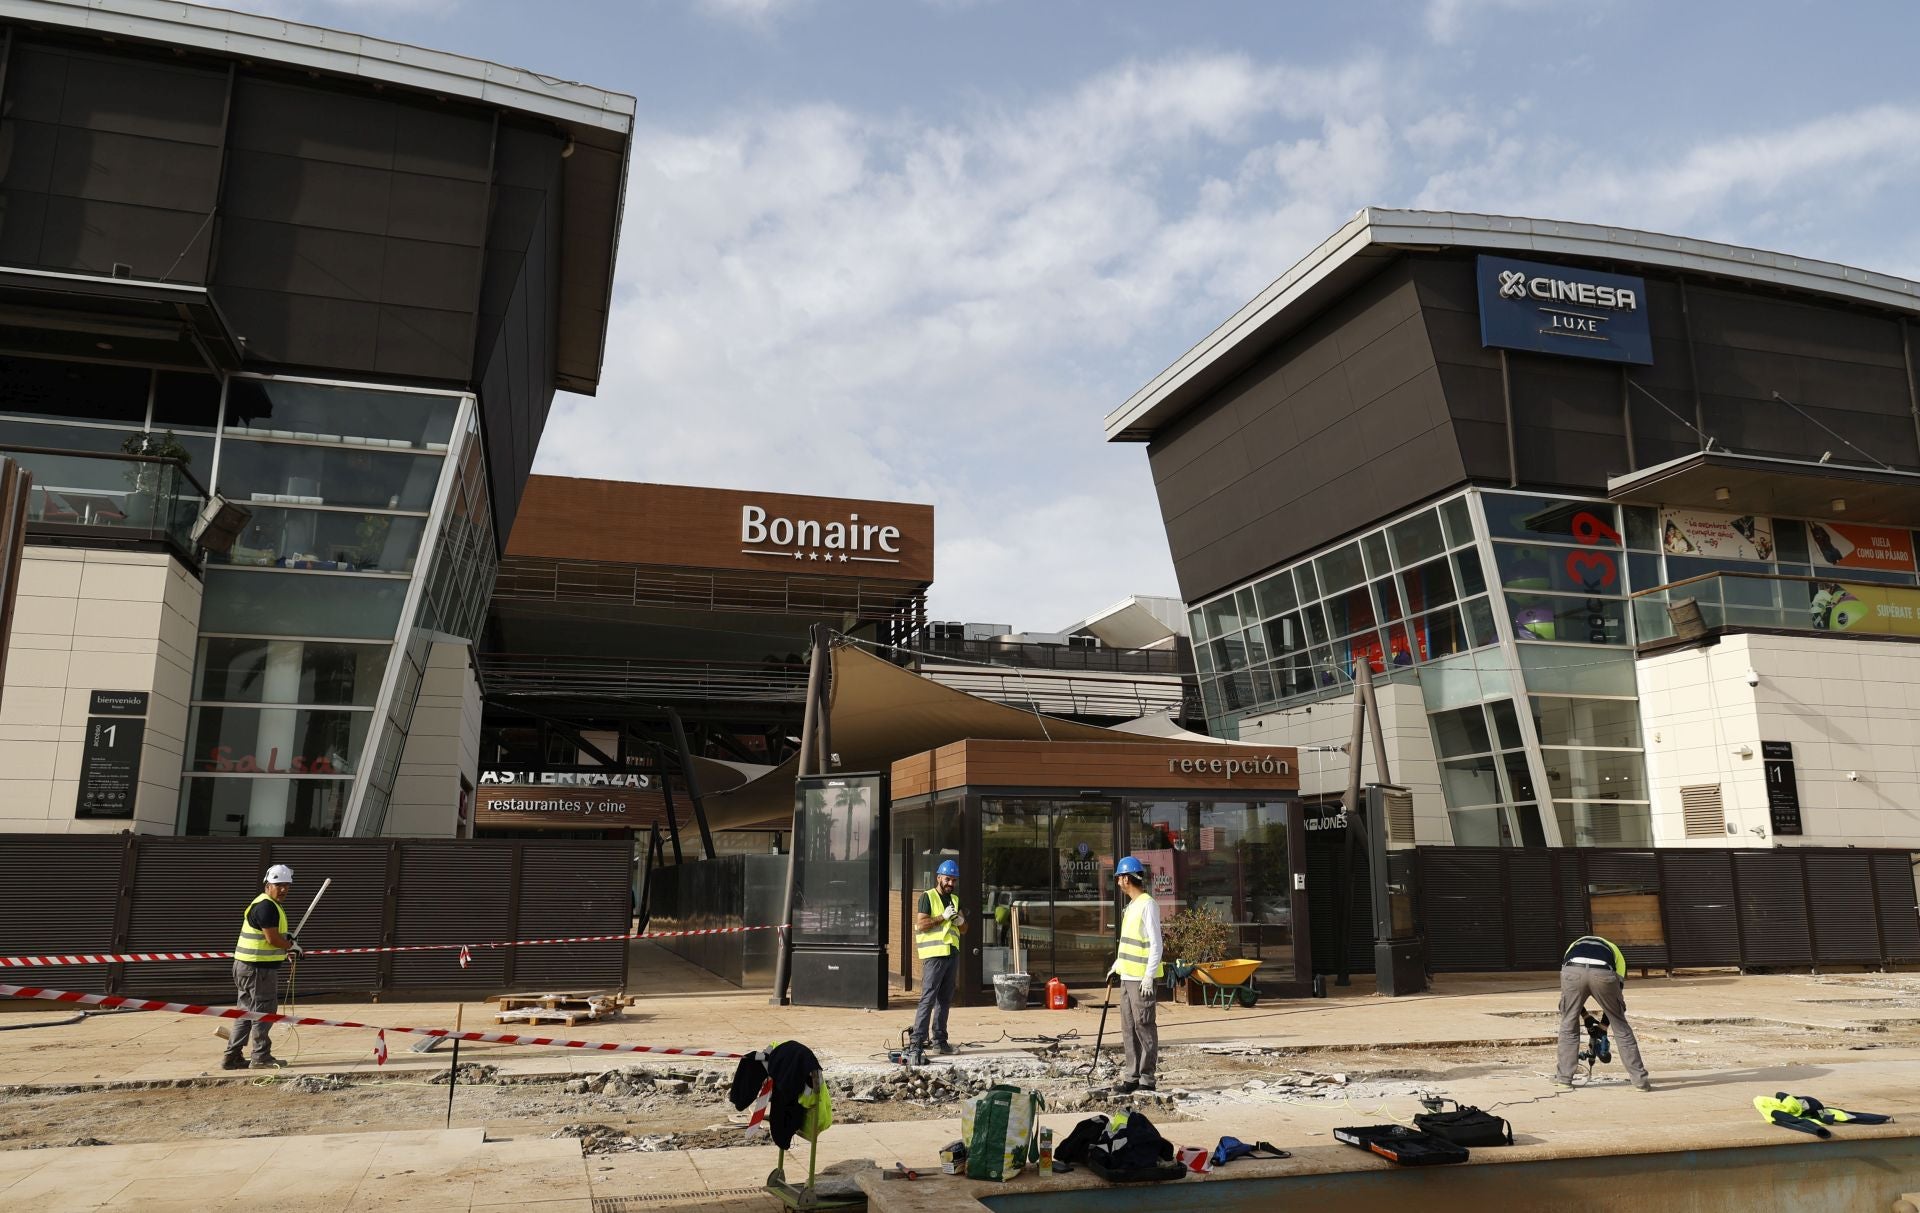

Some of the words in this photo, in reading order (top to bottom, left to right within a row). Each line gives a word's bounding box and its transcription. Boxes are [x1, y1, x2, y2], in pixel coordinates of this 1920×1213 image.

[1530, 277, 1637, 310] CINESA
[1553, 315, 1597, 332] LUXE
[741, 505, 900, 553] Bonaire
[1870, 536, 1891, 548] VUELA
[1856, 547, 1874, 560] COMO
[1874, 548, 1885, 560] UN
[1876, 602, 1913, 619] SUPÉRATE
[97, 695, 142, 706] bienvenido
[93, 724, 102, 748] acceso
[103, 724, 116, 748] 1
[1167, 755, 1290, 780] recepción
[1774, 766, 1783, 783] 1
[487, 798, 581, 812] restaurantes
[584, 801, 594, 815] y
[598, 799, 626, 814] cine
[1317, 815, 1348, 831] JONES
